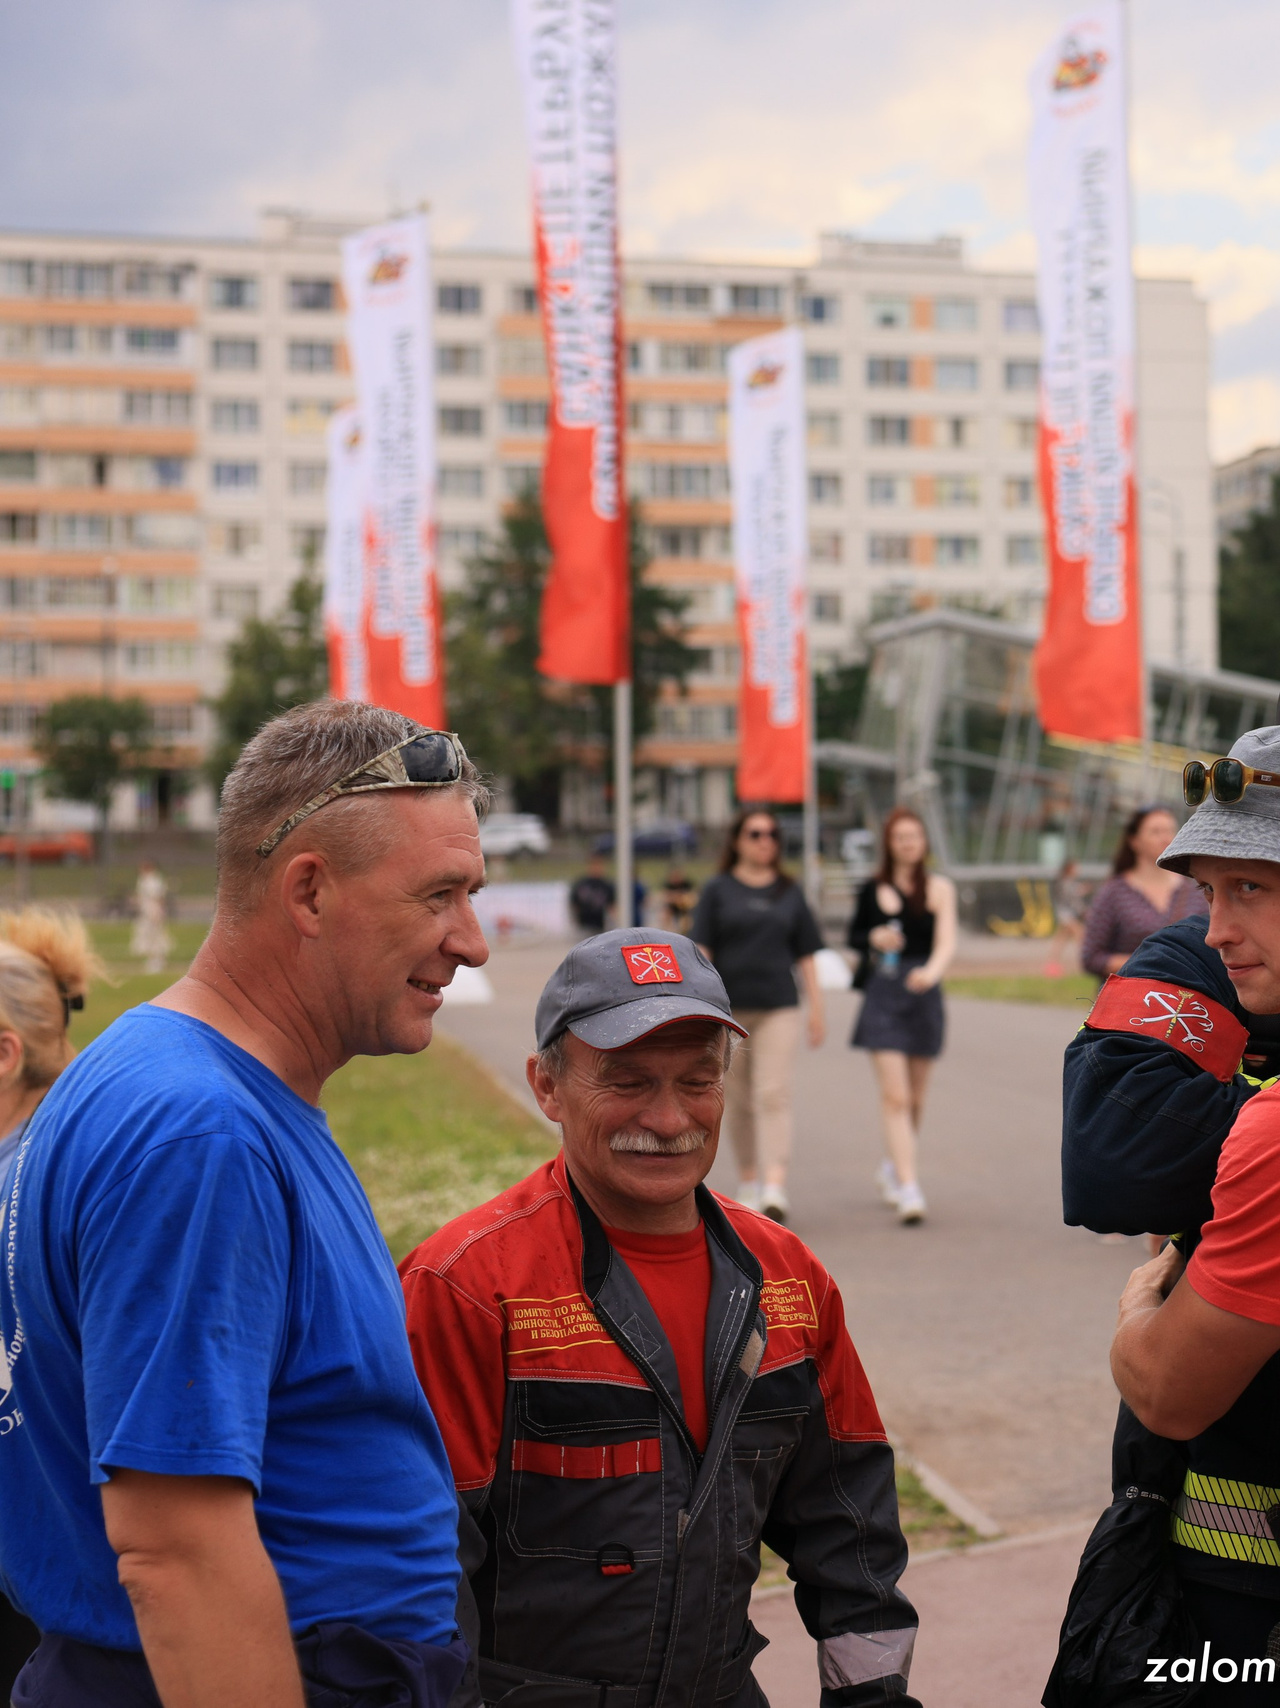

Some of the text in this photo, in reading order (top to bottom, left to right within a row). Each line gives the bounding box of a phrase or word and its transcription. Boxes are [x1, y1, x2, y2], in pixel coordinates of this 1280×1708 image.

[513, 1308, 551, 1319] КОМИТЕТ
[553, 1305, 568, 1317] ПО
[508, 1318, 561, 1331] АКОННОСТИ,
[531, 1323, 607, 1339] И БЕЗОПАСНОСТ
